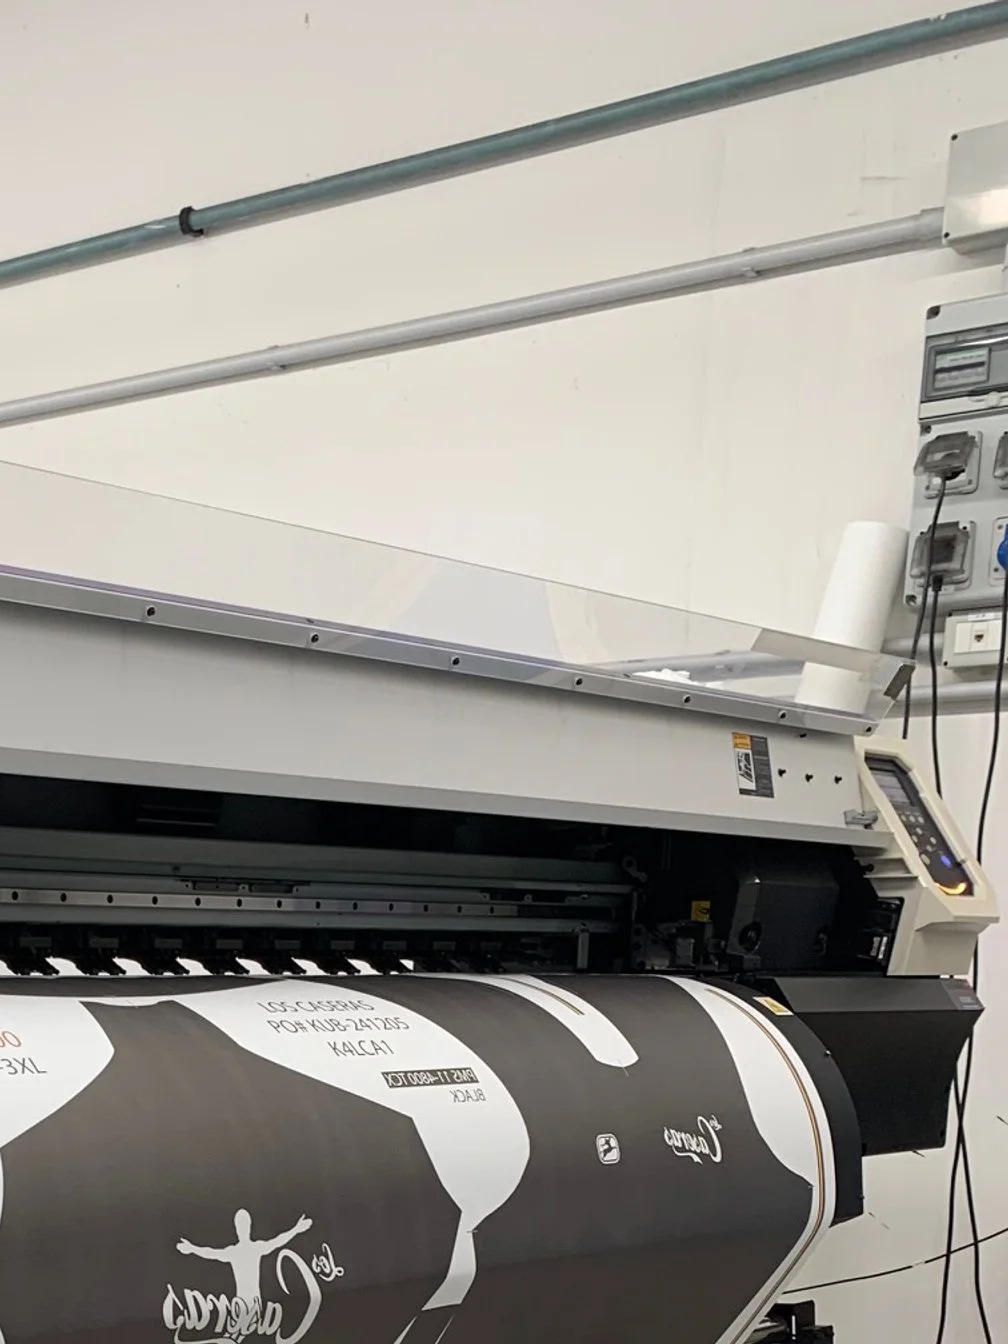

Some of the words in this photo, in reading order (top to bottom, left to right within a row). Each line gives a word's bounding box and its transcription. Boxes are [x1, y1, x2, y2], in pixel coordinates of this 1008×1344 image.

[257, 1001, 298, 1013] LOS
[296, 1000, 375, 1012] CASERAS
[267, 1019, 308, 1034] PO#
[306, 1017, 410, 1033] KUB-241205
[327, 1040, 395, 1057] K4LCA1
